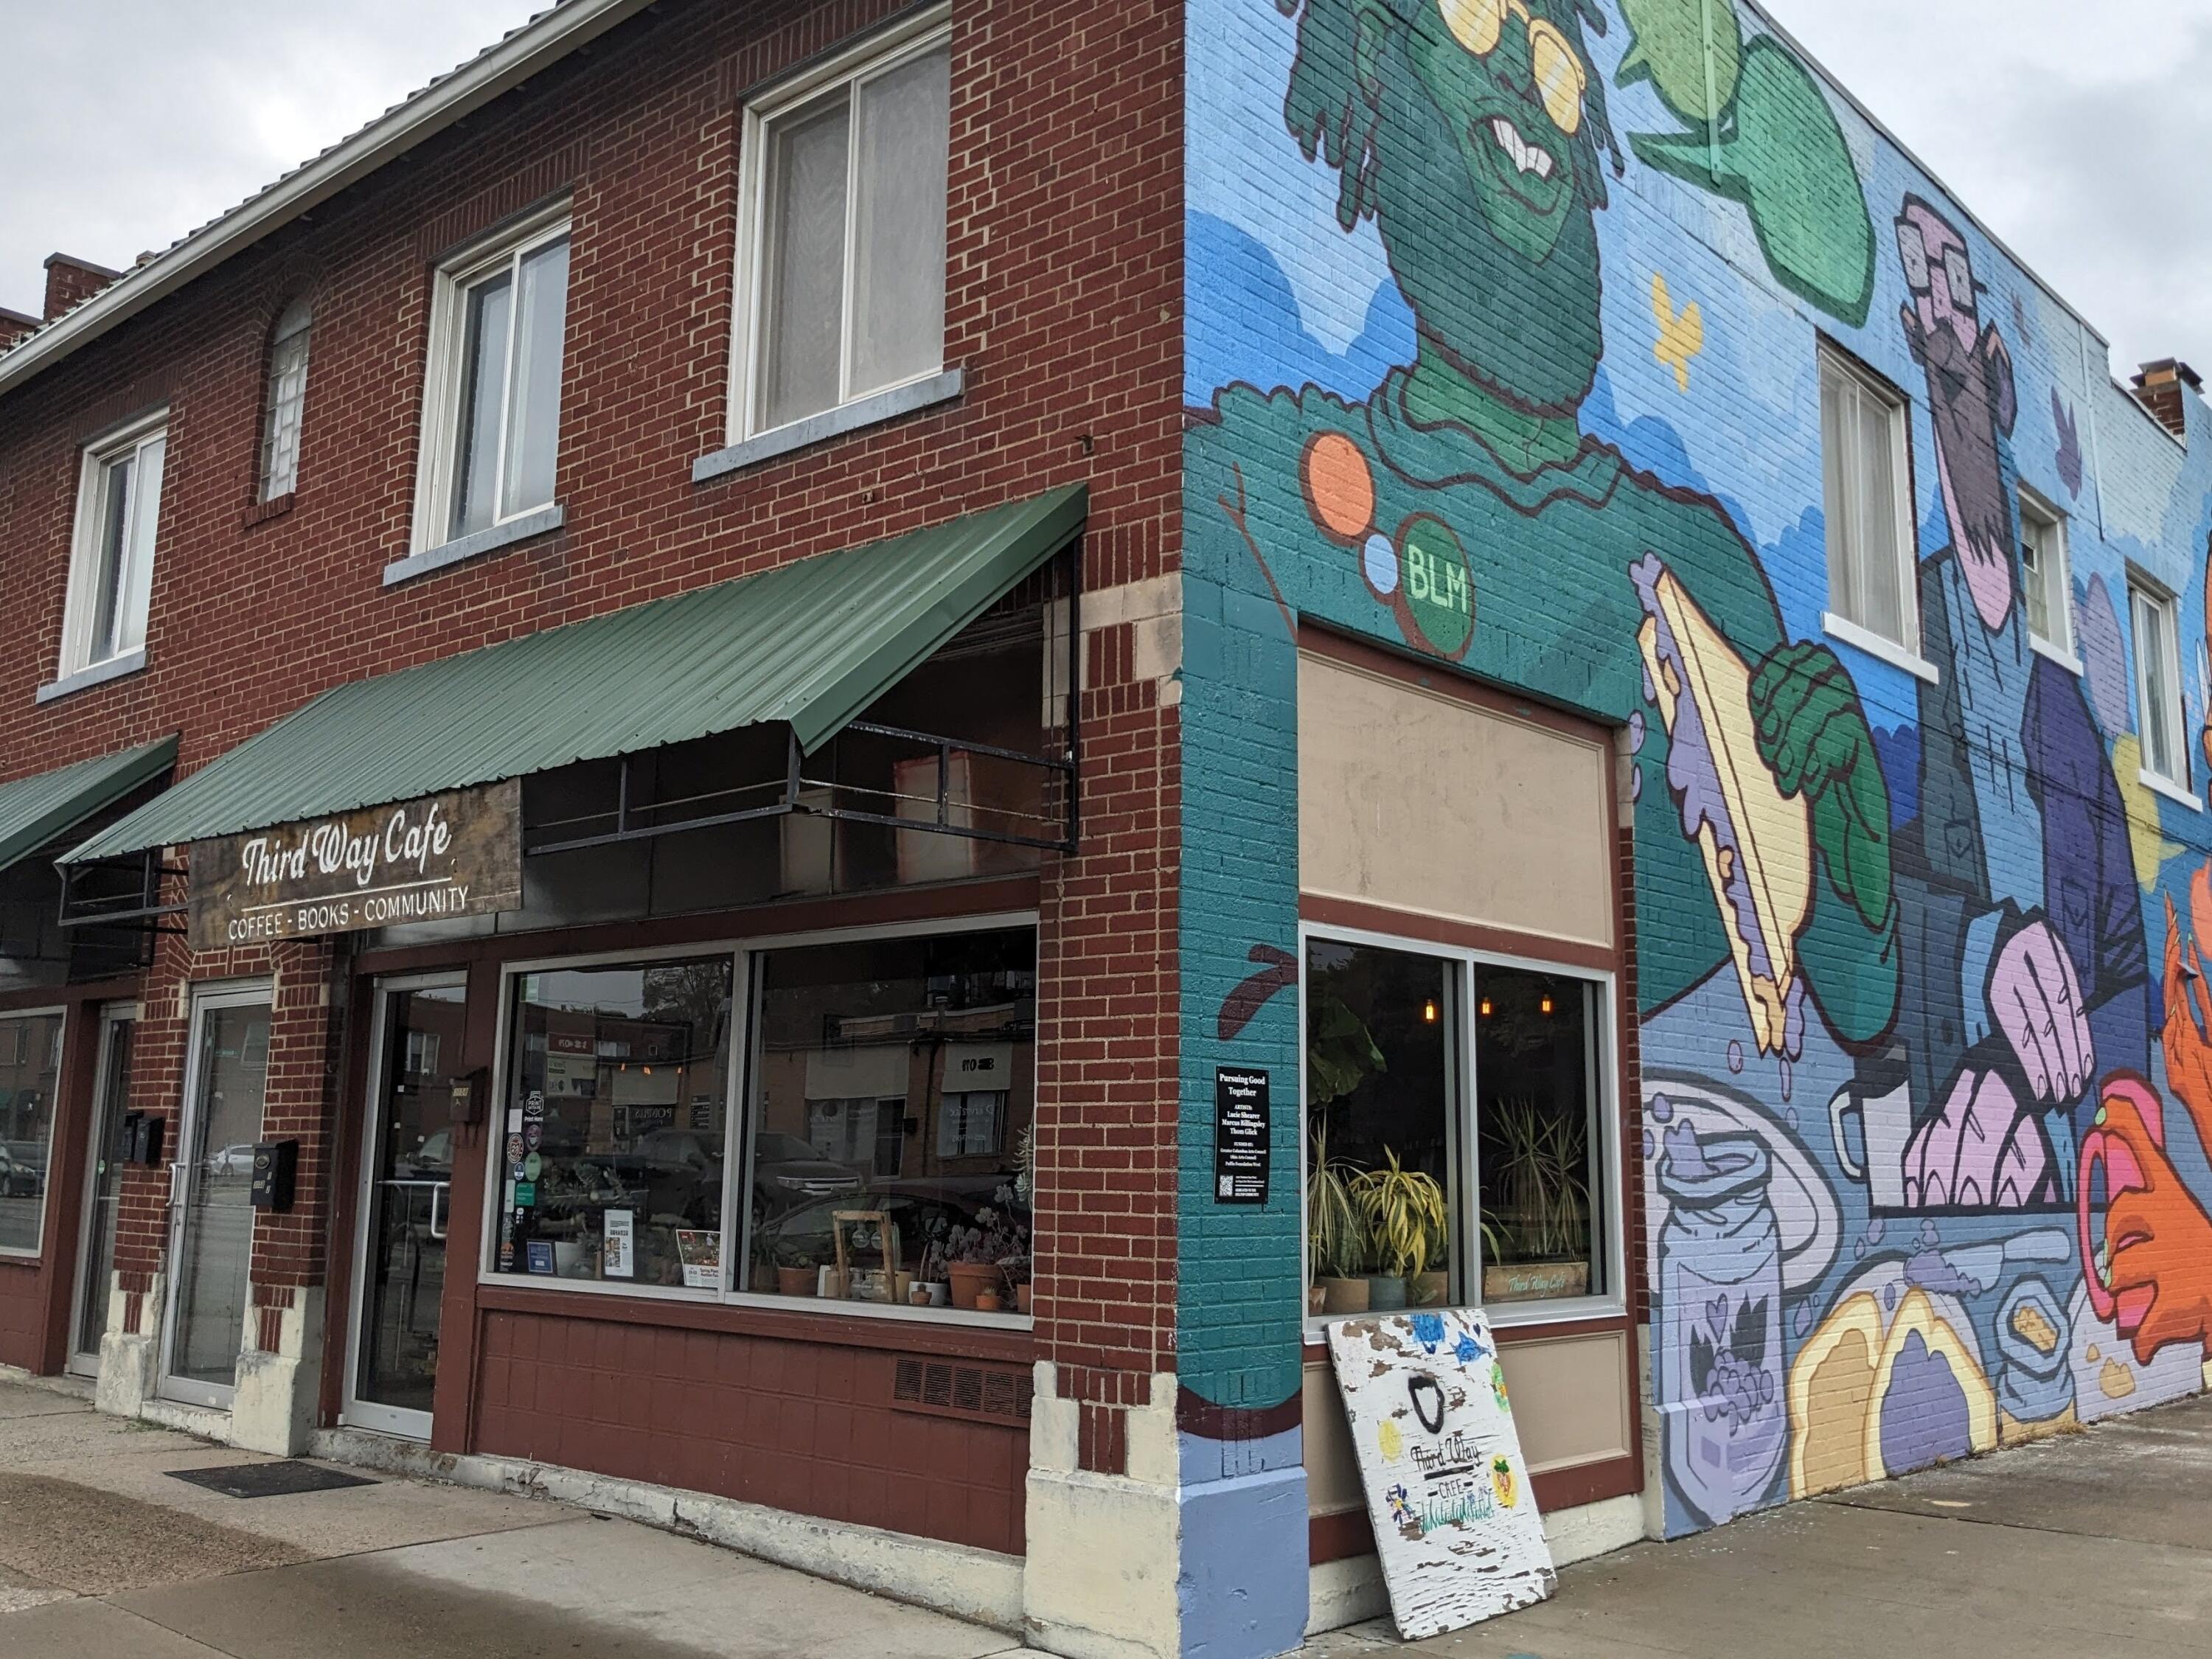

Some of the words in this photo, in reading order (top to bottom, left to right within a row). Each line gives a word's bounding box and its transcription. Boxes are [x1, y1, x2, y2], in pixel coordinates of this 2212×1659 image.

[1408, 543, 1467, 613] BLM
[242, 828, 310, 886] Third
[311, 821, 380, 887] Way
[384, 801, 452, 874] Cafe
[229, 913, 283, 940] COFFEE
[298, 902, 349, 931] BOOKS
[364, 885, 470, 922] COMMUNITY
[1219, 1074, 1249, 1085] Pursuing
[1248, 1076, 1266, 1085] Good
[1228, 1087, 1257, 1097] Together
[1410, 1439, 1447, 1472] Third
[1445, 1436, 1484, 1467] Way
